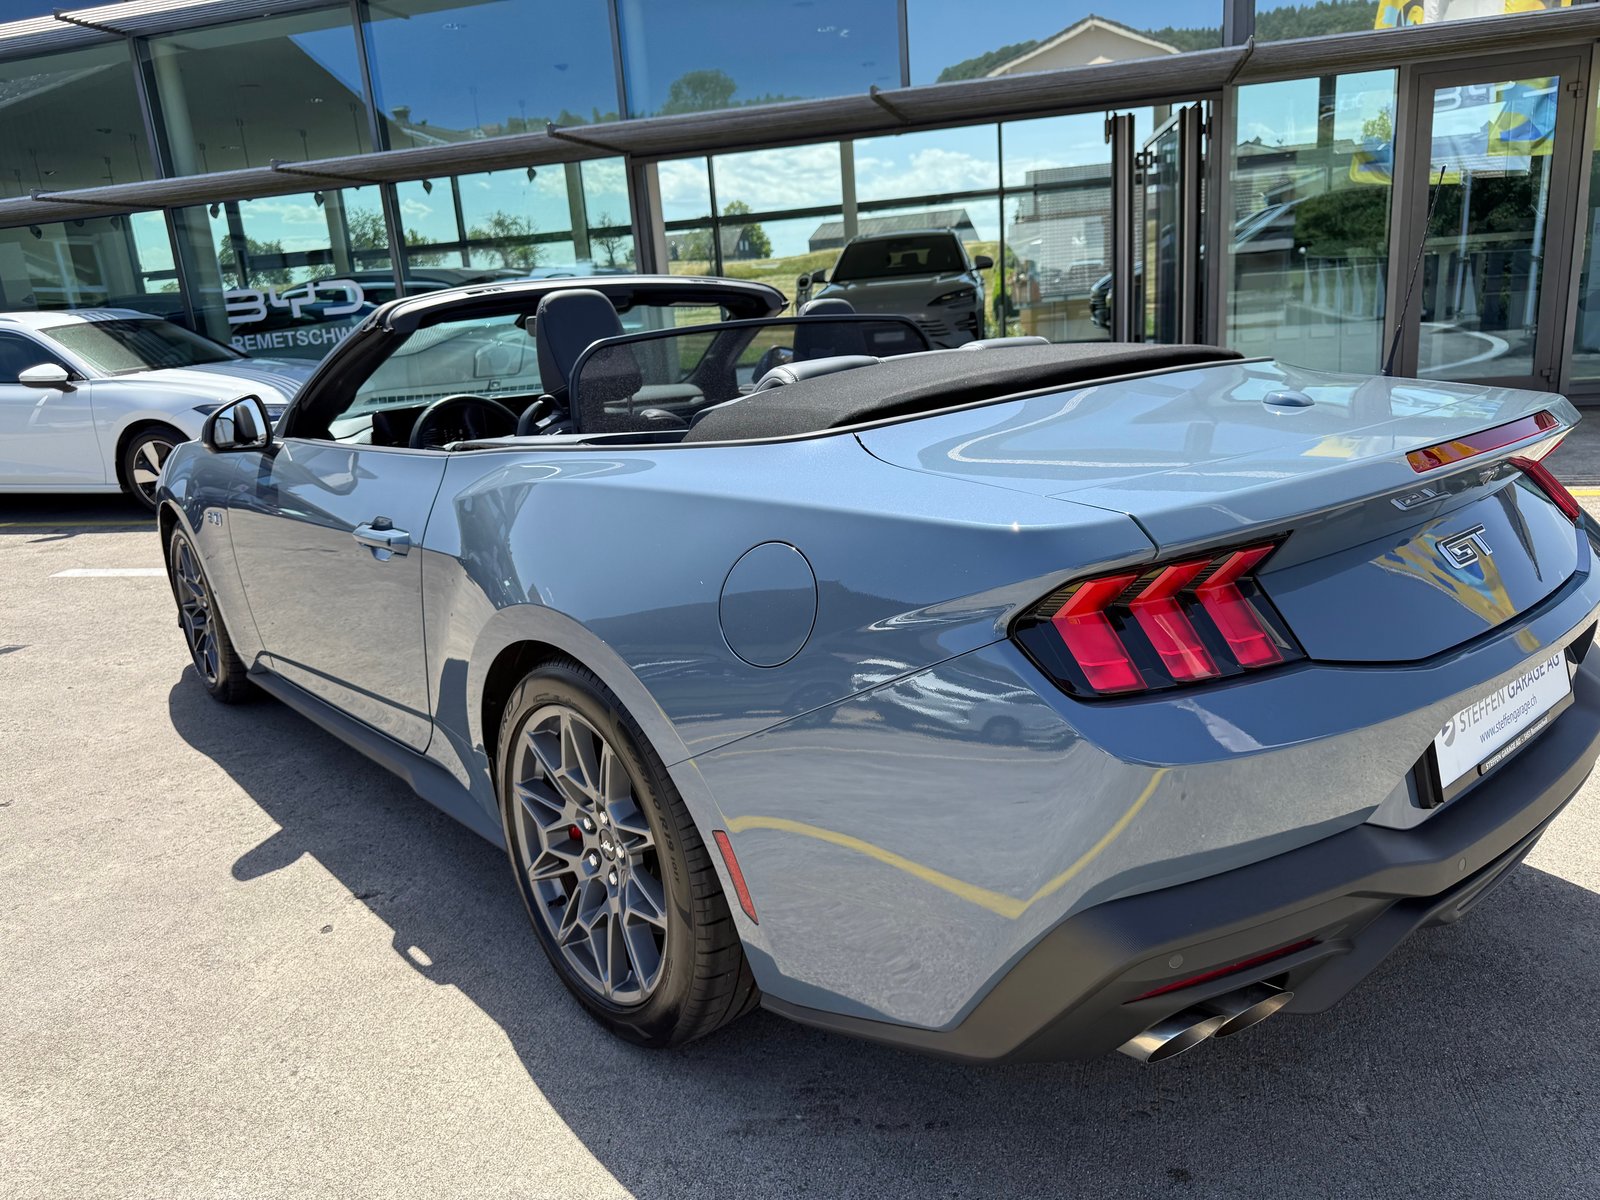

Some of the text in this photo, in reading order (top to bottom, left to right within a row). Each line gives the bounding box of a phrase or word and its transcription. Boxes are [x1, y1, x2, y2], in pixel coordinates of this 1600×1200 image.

[223, 279, 364, 325] BYD
[1436, 523, 1493, 570] GT
[1460, 687, 1505, 733] STEFFEN
[1480, 693, 1538, 743] www.steffengarage.ch
